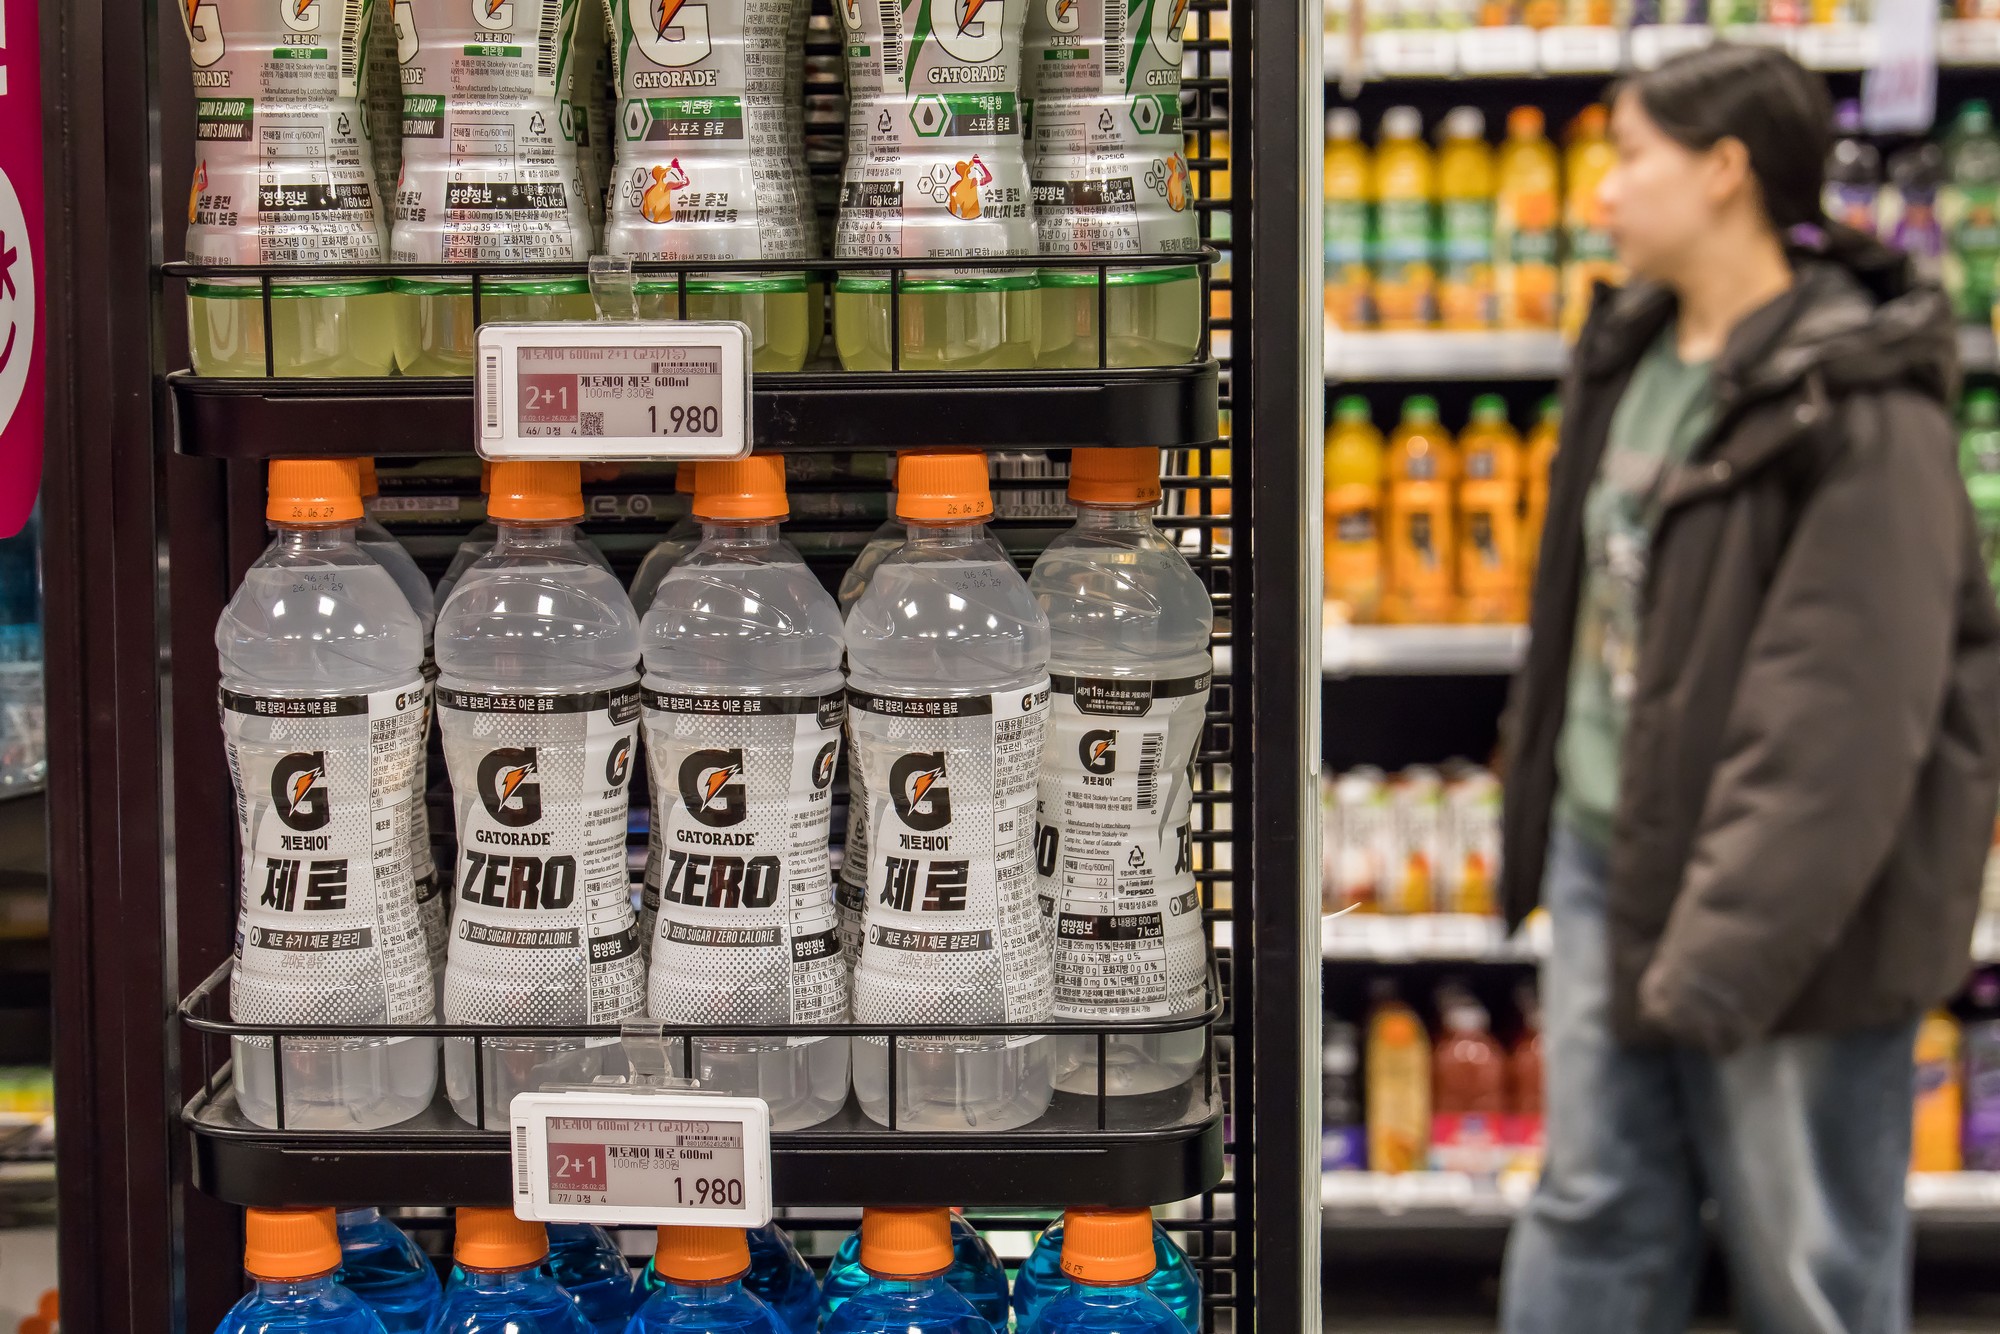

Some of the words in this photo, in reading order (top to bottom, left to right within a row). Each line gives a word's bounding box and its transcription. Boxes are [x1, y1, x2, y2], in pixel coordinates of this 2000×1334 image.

[283, 34, 319, 45] 게토레이
[475, 33, 512, 43] 게토레이
[1051, 37, 1080, 46] 게토레이
[290, 49, 312, 58] 레몬향
[481, 46, 504, 56] 레몬향
[633, 70, 716, 88] GATORADE
[928, 66, 1005, 84] GATORADE
[215, 102, 245, 116] FLAVOR
[411, 99, 437, 112] FLAVOR
[681, 101, 713, 114] 레몬향
[979, 97, 1002, 109] 레몬향
[218, 124, 244, 138] DRINK
[413, 121, 435, 134] DRINK
[668, 122, 699, 136] 스포츠
[704, 122, 724, 135] 음료
[969, 118, 994, 131] 스포츠
[997, 117, 1010, 131] 음료
[264, 192, 308, 206] 영양정보
[450, 189, 492, 203] 영양정보
[677, 194, 700, 207] 수분
[704, 193, 728, 207] 충전
[985, 189, 1003, 202] 수분
[1006, 188, 1020, 202] 충전
[674, 209, 710, 223] 에너지
[714, 209, 738, 223] 보충
[983, 205, 1011, 219] 에너지
[1013, 204, 1026, 217] 보충
[521, 349, 564, 360] 게토레이
[570, 349, 603, 359] 600ml
[608, 349, 628, 359] 2+1
[633, 349, 686, 360] (교차가능)
[580, 377, 623, 388] 게토레이
[628, 377, 652, 387] 레몬
[655, 377, 689, 387] 600ml
[525, 386, 568, 410] 2+1
[585, 388, 622, 399] 100ml당
[627, 388, 654, 399] 330원
[648, 406, 718, 435] 1,980
[526, 427, 540, 435] 46/
[571, 427, 577, 435] 4
[292, 507, 334, 518] 26.06.29
[948, 502, 984, 514] 26.06.29
[1077, 687, 1090, 696] 세계
[1092, 686, 1104, 697] 1위
[1105, 690, 1130, 698] 스포츠음료
[255, 701, 266, 712] 제로
[268, 701, 285, 714] 칼로리
[287, 702, 306, 713] 스포츠
[307, 702, 321, 714] 이온
[323, 702, 337, 714] 음료
[456, 695, 468, 707] 제로
[470, 696, 490, 709] 칼로리
[493, 698, 516, 709] 스포츠
[519, 699, 534, 710] 이온
[538, 699, 553, 710] 음료
[657, 696, 669, 707] 제로
[671, 698, 692, 710] 칼로리
[695, 700, 720, 710] 스포츠
[723, 700, 740, 712] 이온
[744, 700, 761, 712] 음료
[873, 698, 884, 710] 제로
[885, 700, 903, 713] 칼로리
[905, 703, 924, 713] 스포츠
[926, 703, 940, 715] 이온
[943, 703, 958, 714] 음료
[1079, 729, 1116, 774] G
[477, 747, 541, 827] G
[678, 748, 746, 827] G
[1082, 776, 1112, 786] 게토레이
[271, 751, 329, 831] G
[889, 752, 951, 831] G
[1068, 820, 1094, 828] Manufactured
[281, 835, 329, 851] 게토레이
[476, 830, 551, 846] GATORADE
[676, 830, 755, 846] GATORADE
[899, 834, 949, 851] 게토레이
[260, 857, 348, 912] 제로
[461, 848, 576, 910] ZERO
[664, 849, 781, 908] ZERO
[880, 856, 969, 912] 제로
[1061, 919, 1093, 934] 영양정보
[1110, 916, 1117, 927] 총
[1118, 917, 1137, 927] 내용량
[1138, 916, 1151, 925] 600
[1152, 914, 1160, 923] ml
[471, 926, 487, 940] ZERO
[487, 929, 511, 943] SUGAR
[516, 933, 536, 945] ZERO
[539, 931, 573, 945] CALORIE
[672, 925, 687, 939] ZERO
[687, 928, 711, 941] SUGAR
[717, 931, 737, 943] ZERO
[739, 930, 775, 943] CALORIE
[1137, 927, 1142, 937] 7
[1145, 925, 1161, 935] kcal
[267, 933, 283, 947] 제로
[285, 934, 302, 948] 슈거
[310, 934, 328, 948] 제로
[332, 932, 360, 948] 칼로리
[795, 937, 826, 956] 영양정보
[885, 931, 901, 946] 제로
[903, 933, 920, 948] 슈거
[928, 935, 947, 949] 제로
[951, 934, 979, 950] 칼로리
[1085, 943, 1094, 951] mg
[1113, 940, 1136, 950] 탄수화물
[592, 942, 622, 959] 영양정보
[551, 1119, 591, 1130] 게토레이
[597, 1121, 630, 1131] 600ml
[633, 1122, 653, 1132] 2+1
[658, 1122, 710, 1133] (교차가능)
[608, 1147, 650, 1159] 게토레이
[654, 1148, 675, 1159] 제로
[680, 1150, 713, 1160] 600ml
[556, 1155, 596, 1178] 2+1
[613, 1158, 649, 1169] 100ml당
[653, 1160, 680, 1170] 330원
[674, 1177, 742, 1206] 1,980
[601, 1195, 606, 1203] 4
